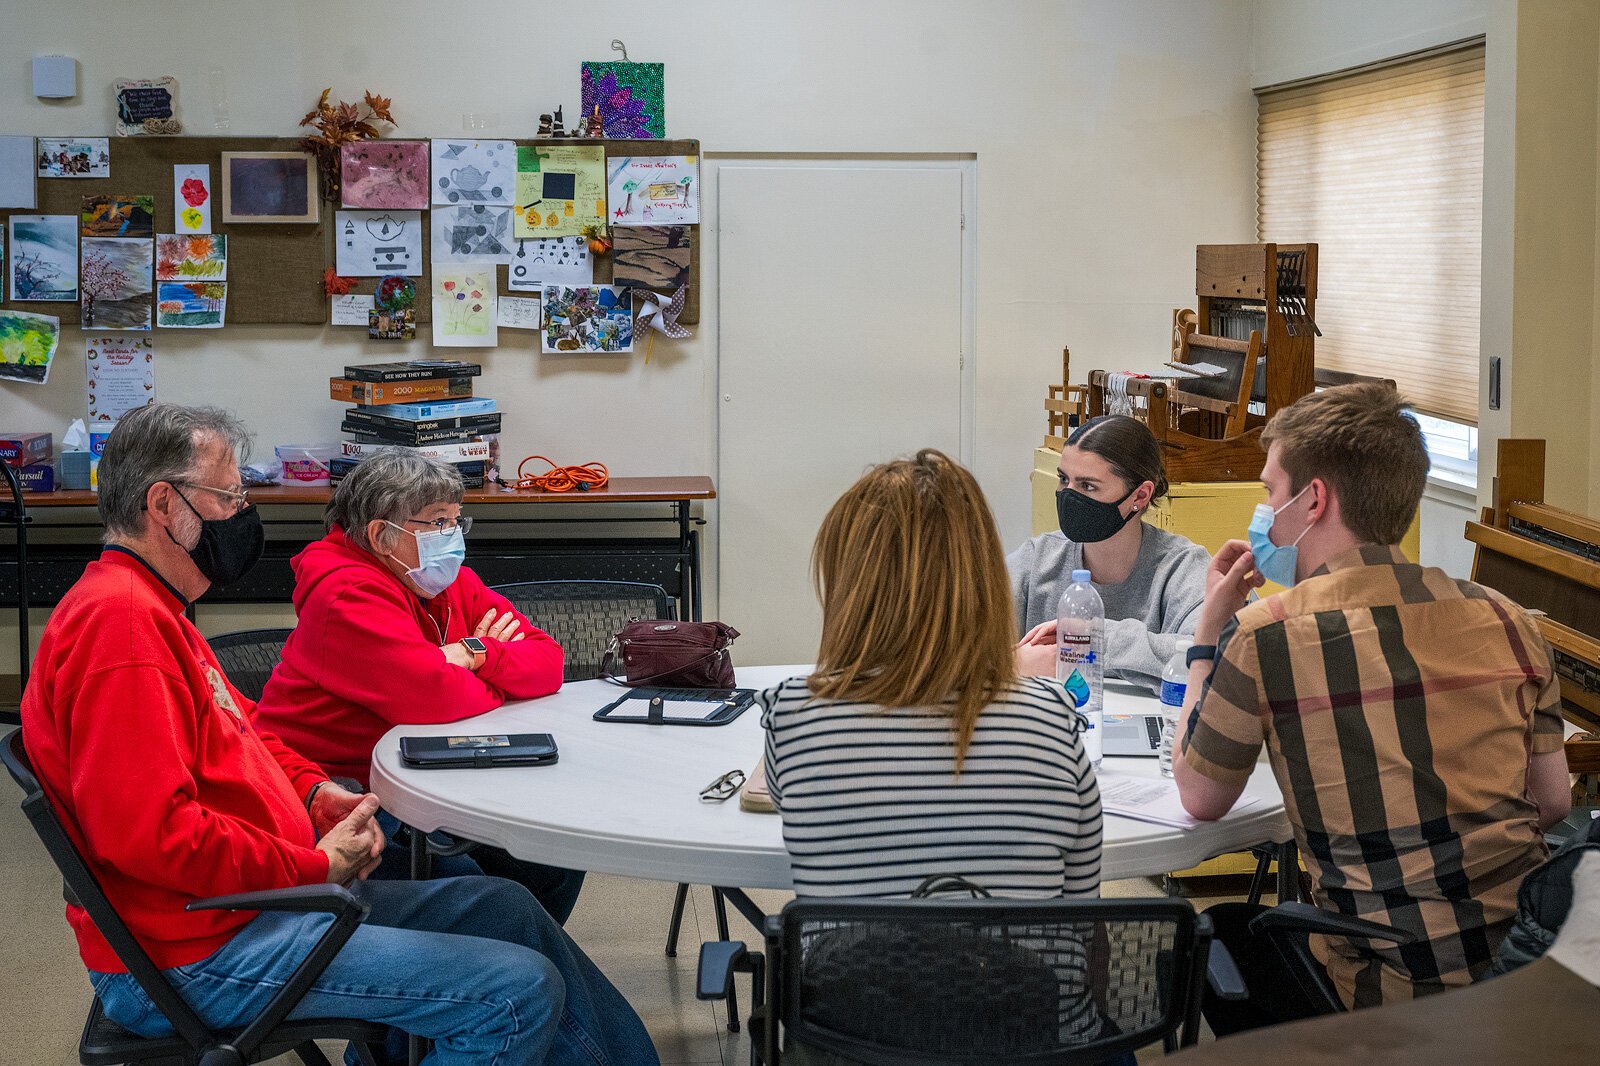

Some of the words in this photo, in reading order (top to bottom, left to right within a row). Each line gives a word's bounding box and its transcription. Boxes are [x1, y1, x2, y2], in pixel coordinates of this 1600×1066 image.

[394, 386, 413, 395] 2000
[342, 443, 361, 456] 1000
[1060, 650, 1085, 659] Alkaline
